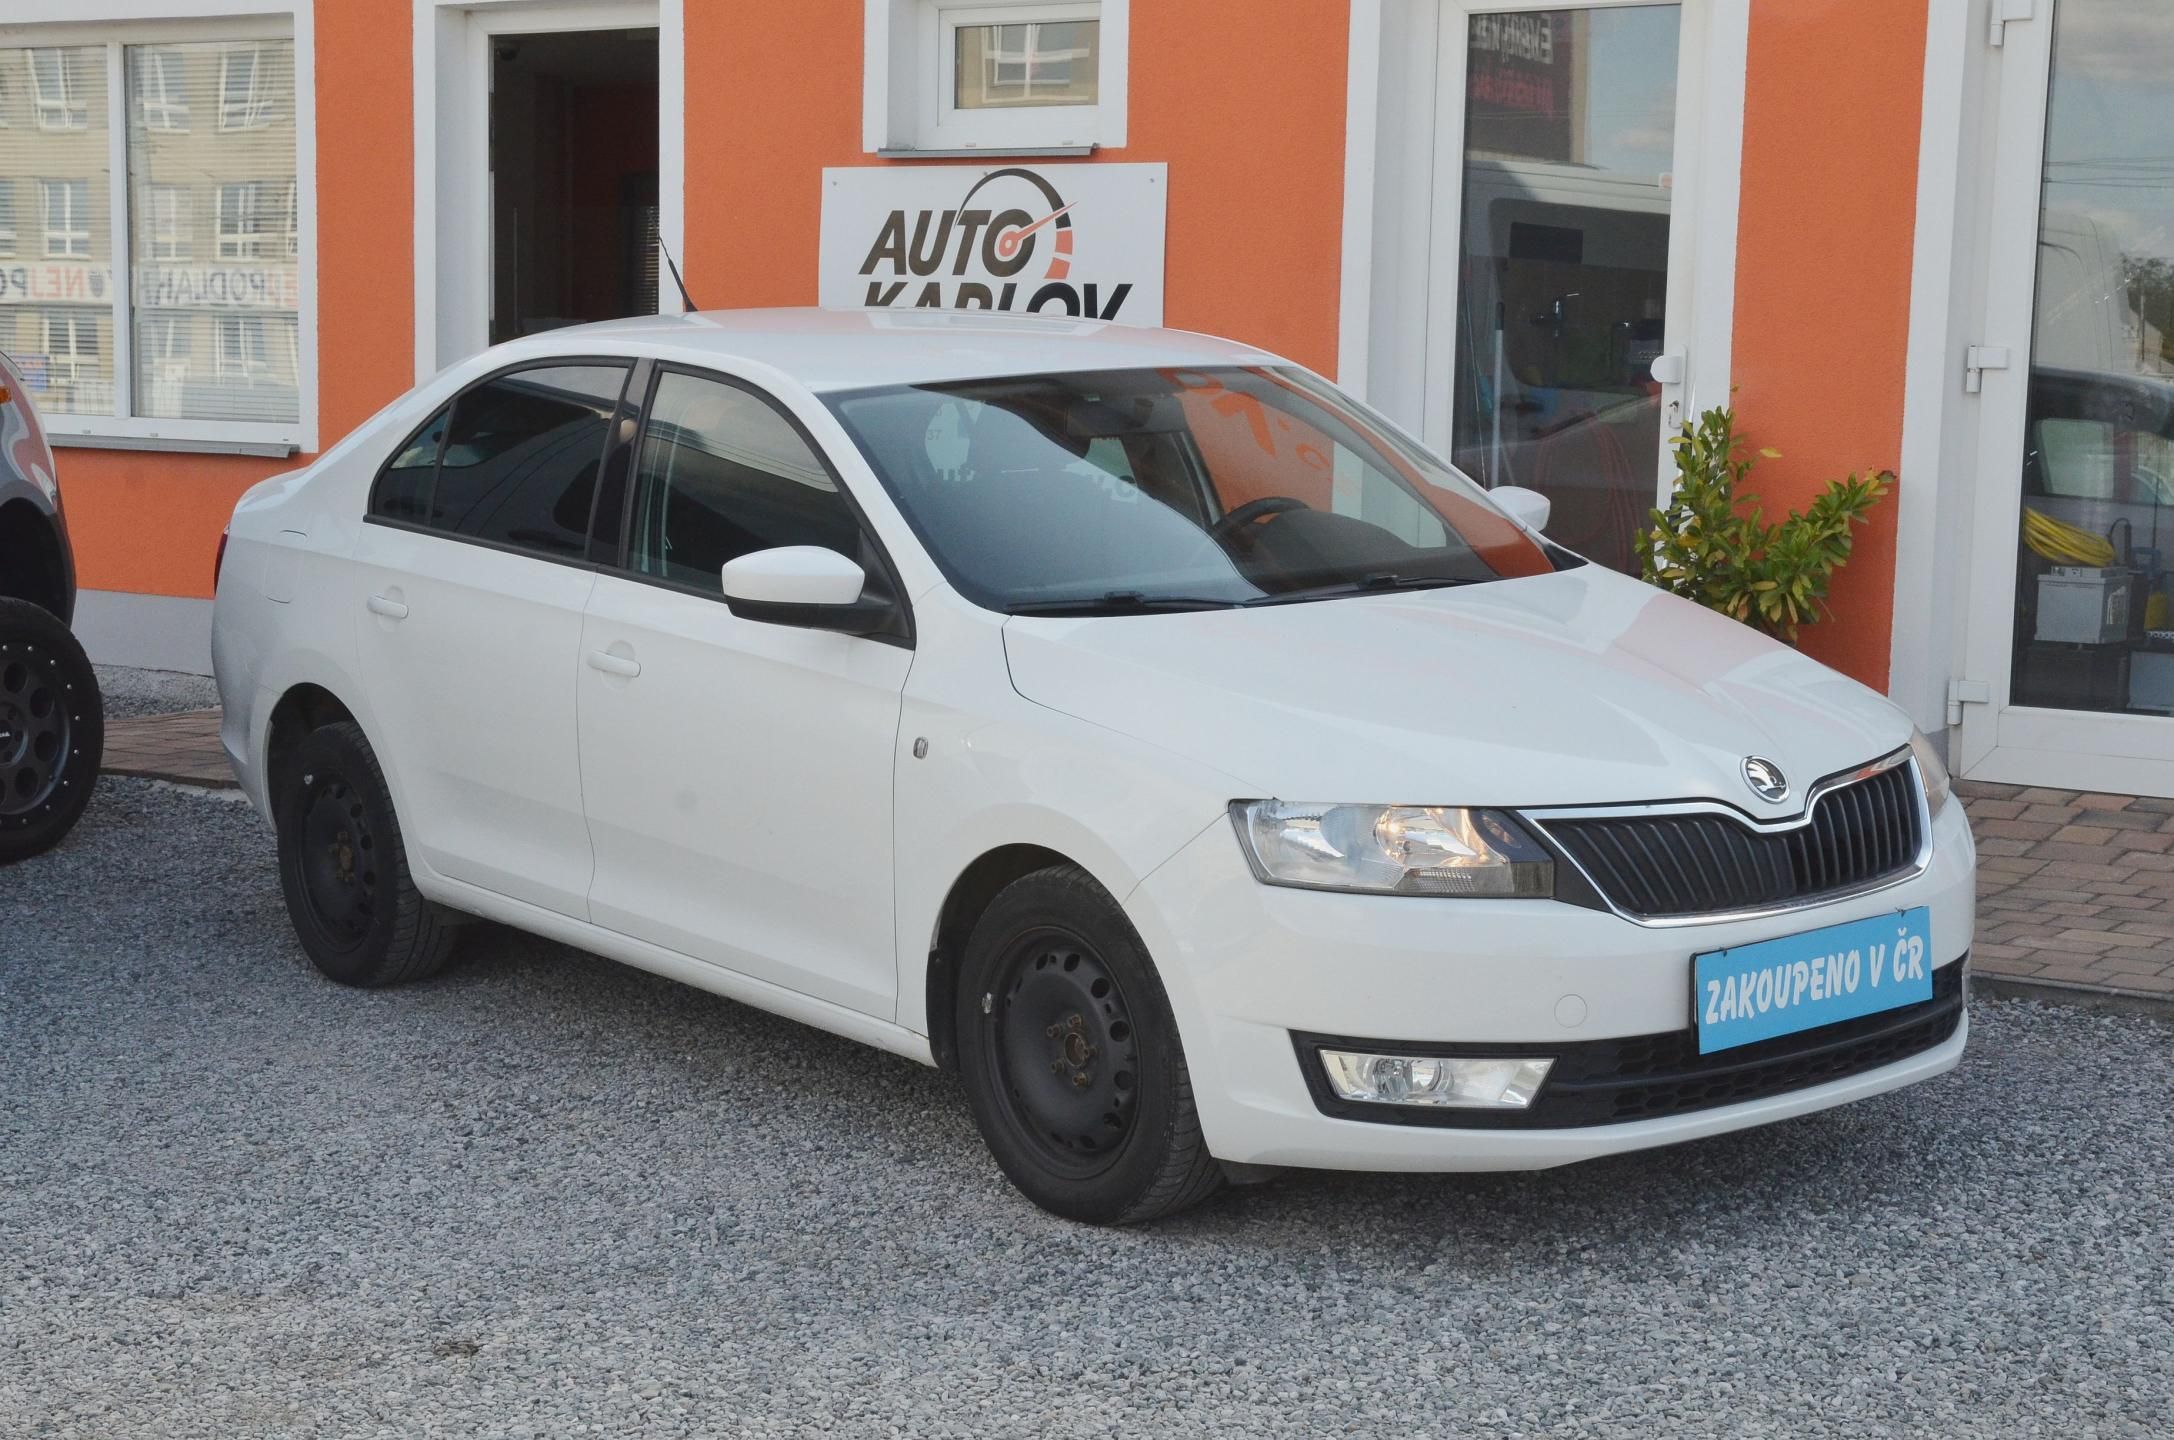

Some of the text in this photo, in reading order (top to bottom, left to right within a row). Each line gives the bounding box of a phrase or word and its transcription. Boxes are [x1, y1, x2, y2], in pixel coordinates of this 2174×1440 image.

[858, 208, 1036, 278] AUTO
[1705, 927, 1924, 1024] ZAKOUPENO V ČR
